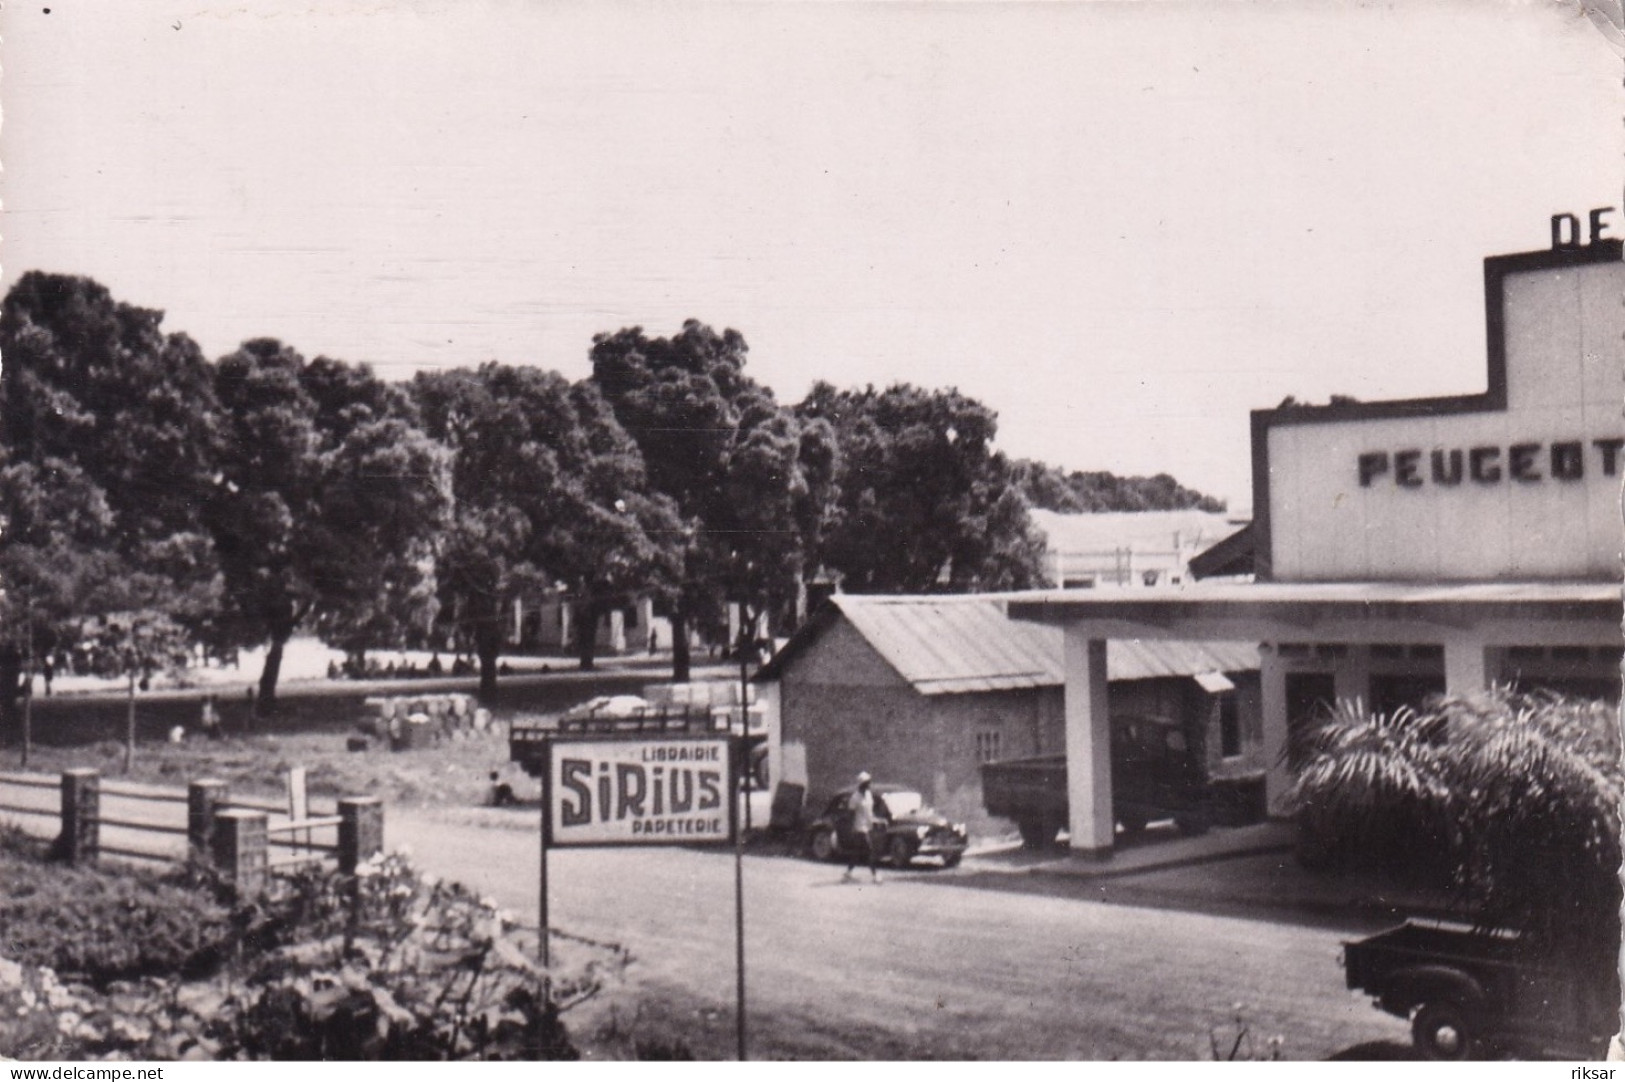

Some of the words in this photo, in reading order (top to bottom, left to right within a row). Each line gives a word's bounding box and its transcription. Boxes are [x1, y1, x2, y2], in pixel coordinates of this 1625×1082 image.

[1551, 206, 1616, 250] DE
[1357, 438, 1624, 489] PEUGEOT
[632, 817, 721, 834] PAPETERIE
